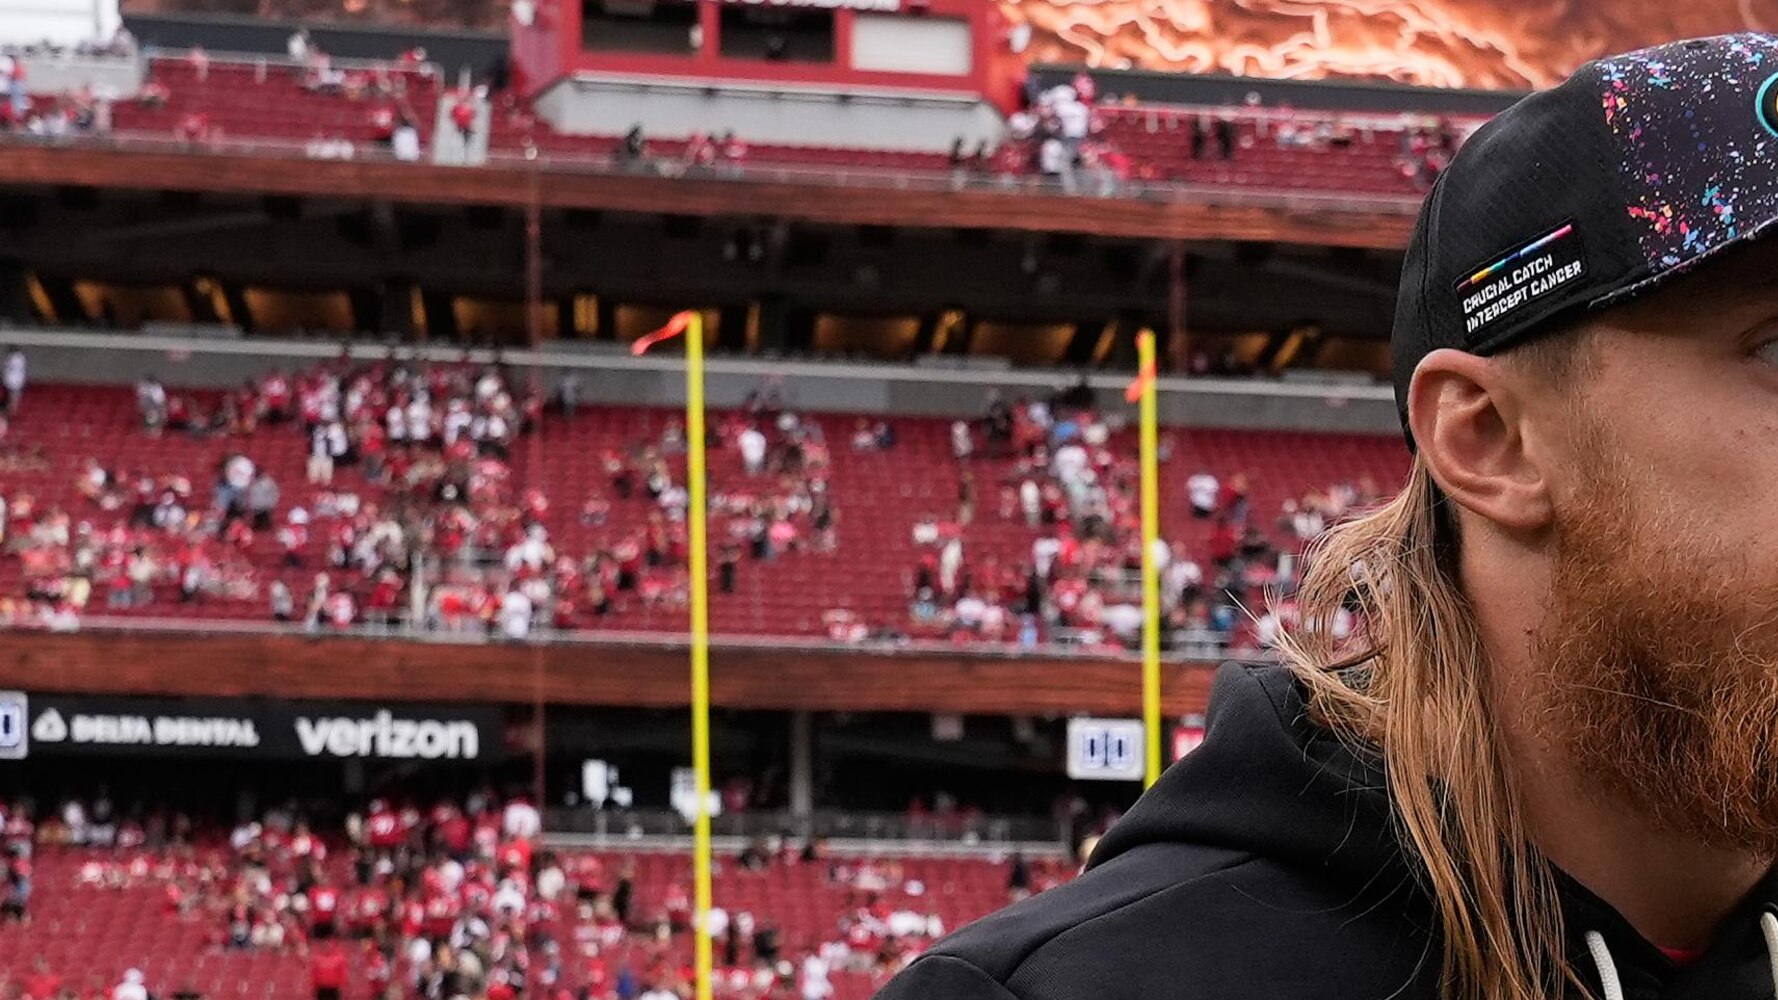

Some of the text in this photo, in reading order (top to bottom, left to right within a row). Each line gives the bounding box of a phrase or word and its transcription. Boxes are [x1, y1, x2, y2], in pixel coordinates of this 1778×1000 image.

[1463, 253, 1553, 314] CRUCIAL CATCH
[1466, 260, 1582, 333] INTERCEPT CANCER
[71, 713, 260, 747] DELTA DENTAL
[295, 708, 480, 759] verizon
